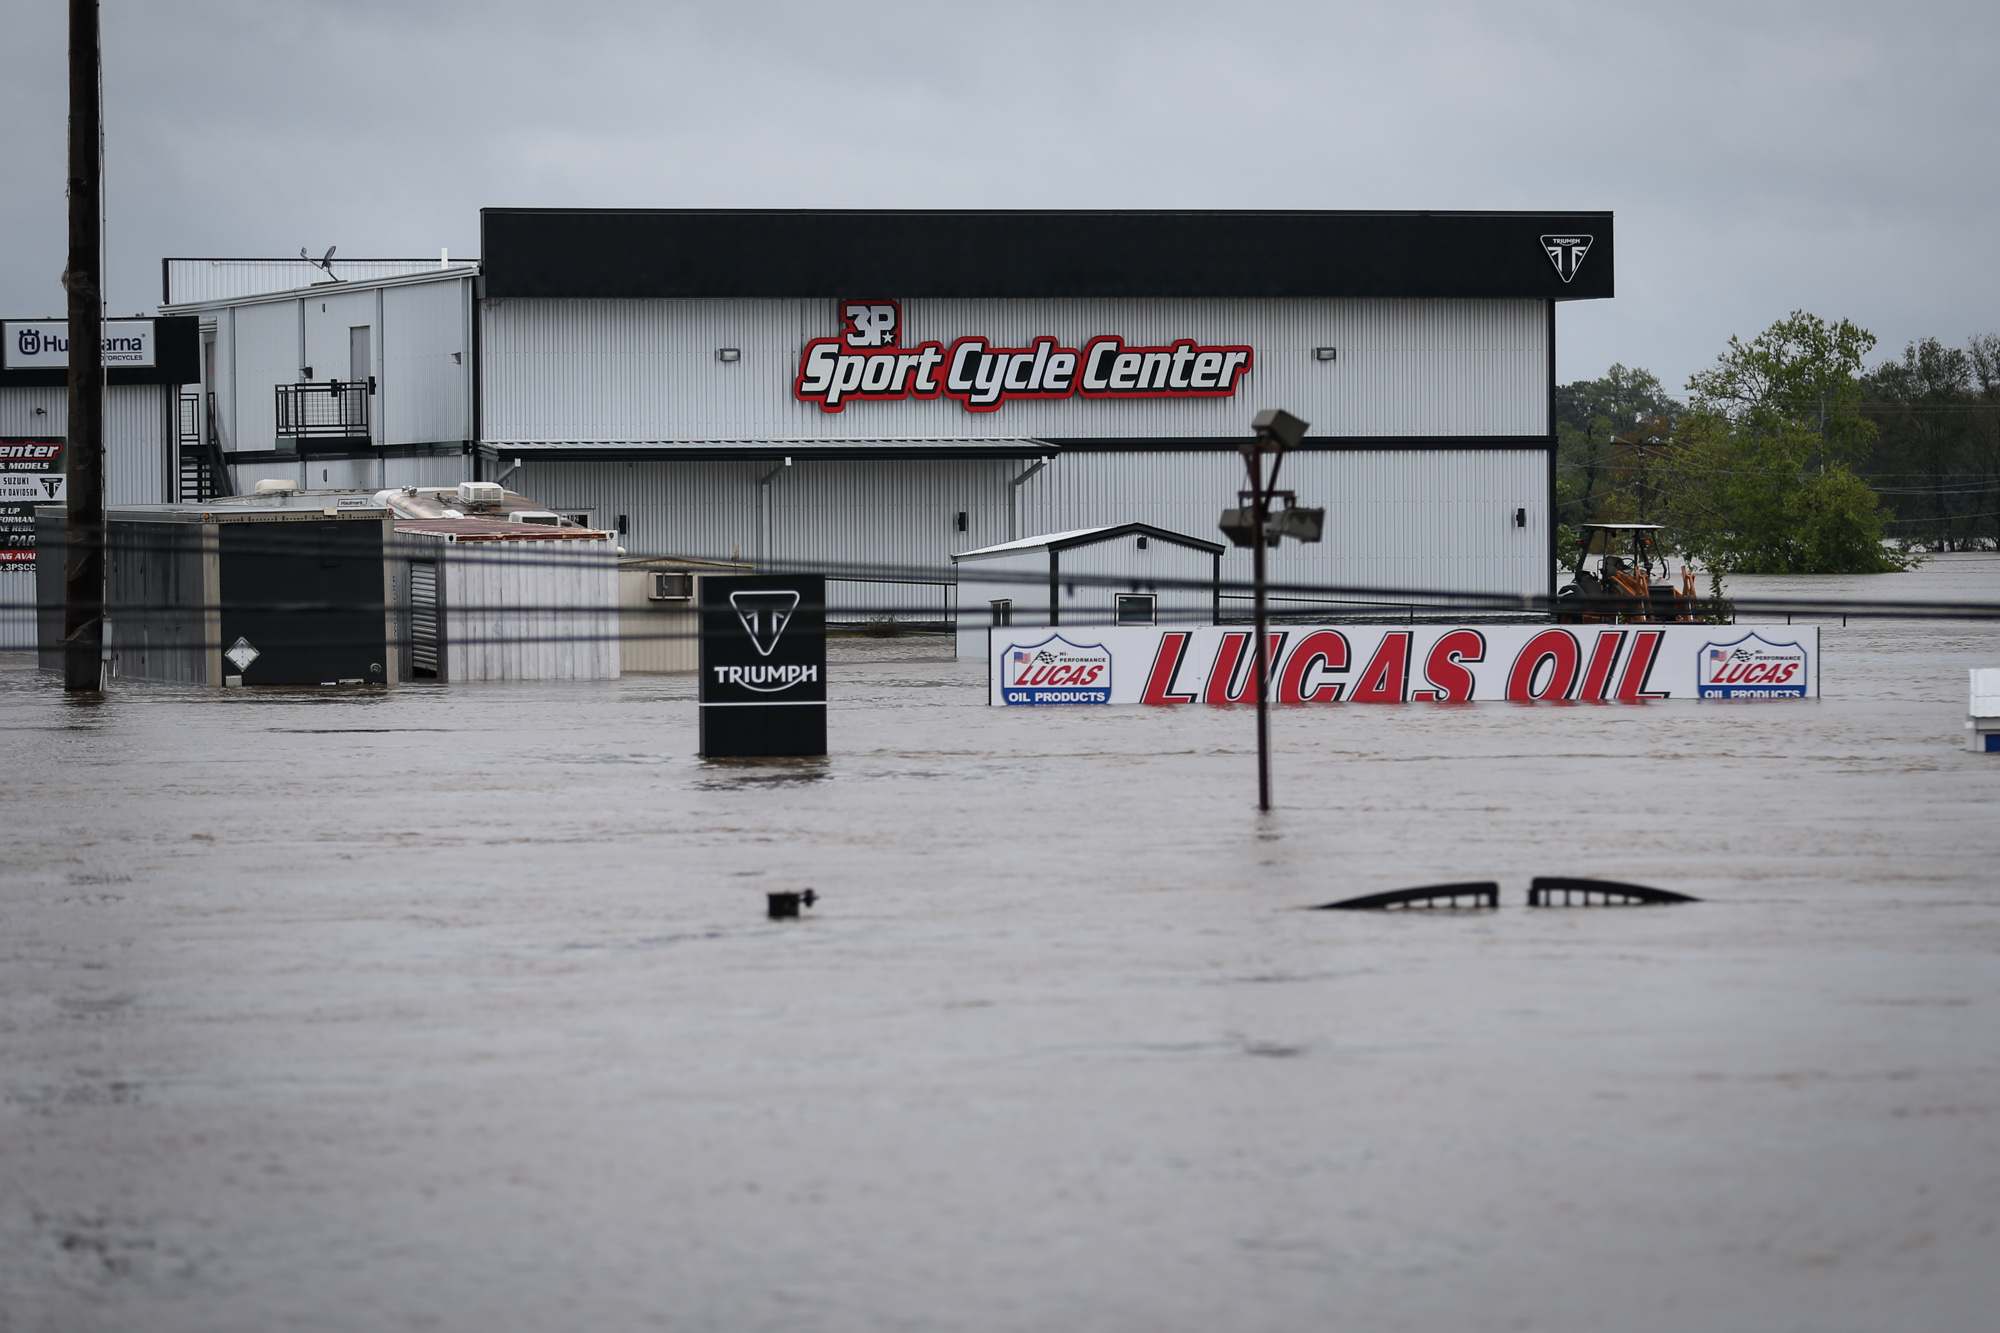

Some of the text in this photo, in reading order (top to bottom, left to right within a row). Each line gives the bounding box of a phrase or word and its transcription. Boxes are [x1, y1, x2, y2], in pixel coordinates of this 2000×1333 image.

[846, 305, 895, 346] 3P
[44, 336, 142, 351] Huarna
[801, 341, 1248, 404] Sport Cycle Center
[8, 462, 50, 470] MODELS
[3, 477, 29, 485] SUZUKI
[8, 488, 38, 497] DAVIDSON
[7, 507, 21, 515] UP
[1139, 628, 1671, 703] LUCAS OIL
[713, 665, 818, 692] TRIUMPH
[1014, 665, 1104, 686] LUCAS
[1709, 663, 1800, 684] LUCAS
[1008, 691, 1106, 702] OIL PRODUCTS
[1704, 690, 1801, 698] OIL PRODUCTS
